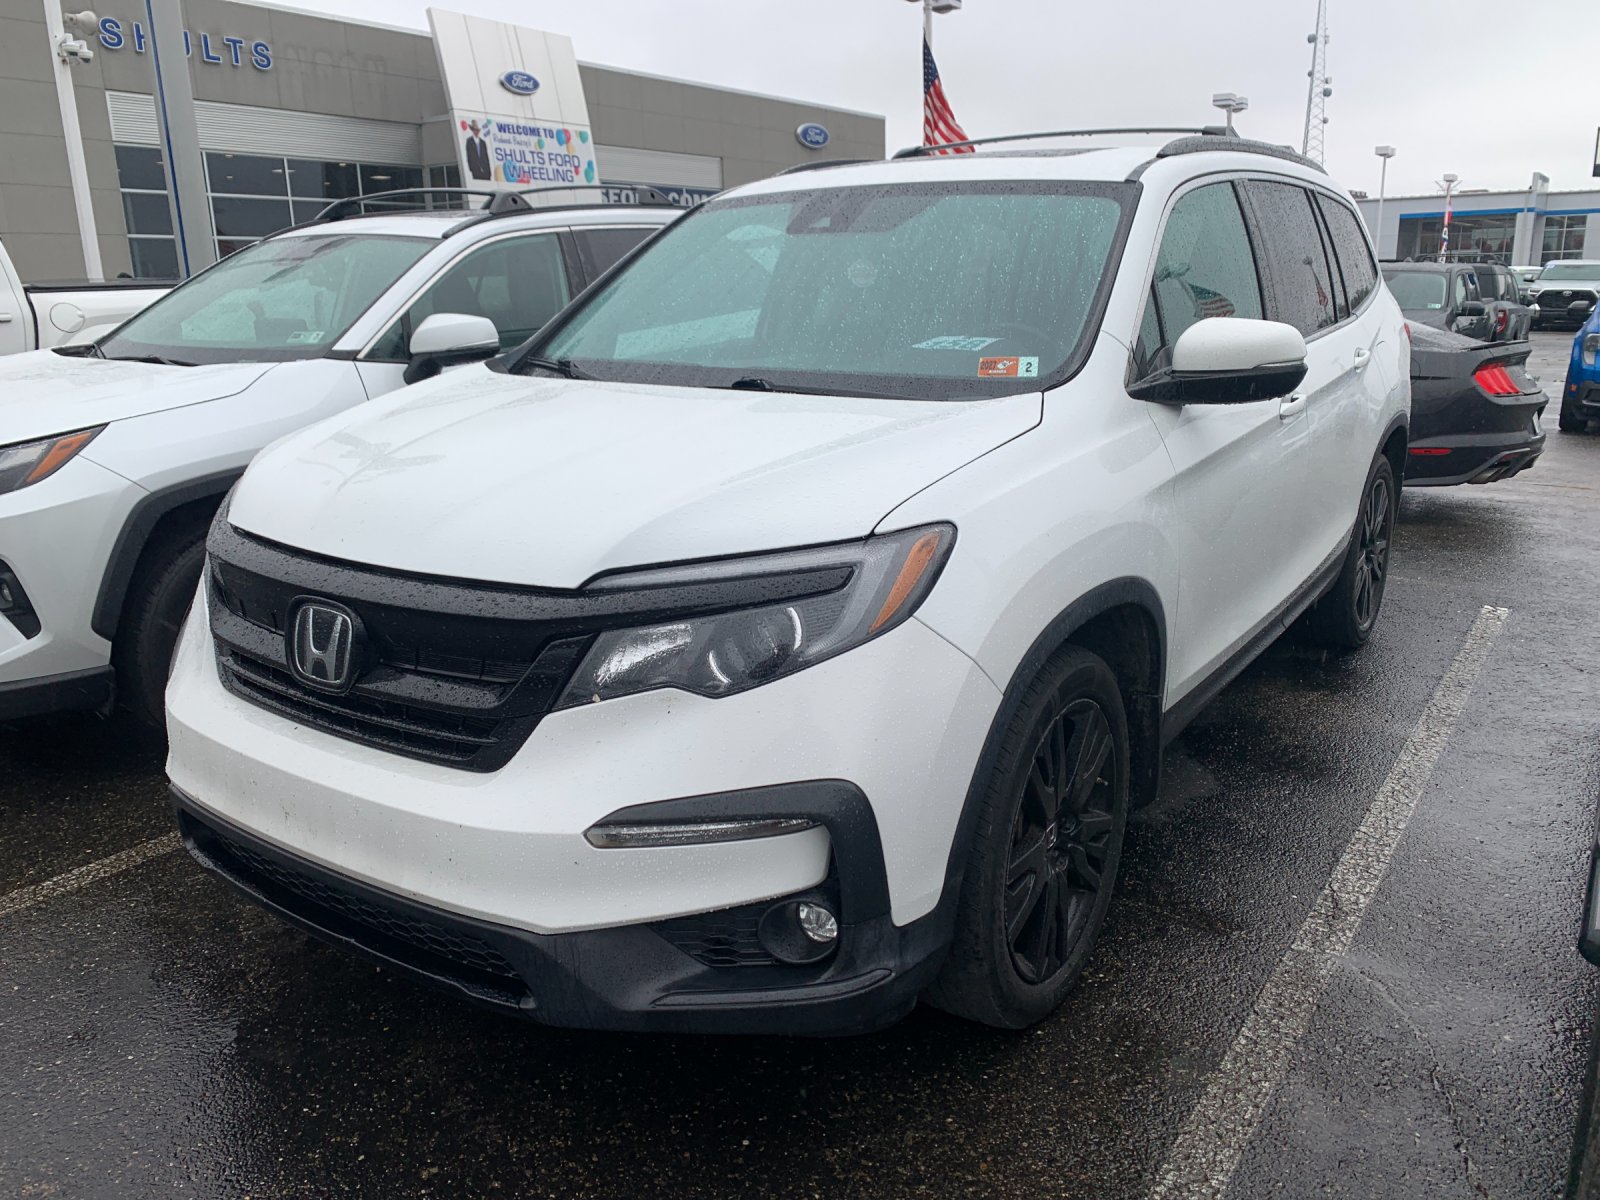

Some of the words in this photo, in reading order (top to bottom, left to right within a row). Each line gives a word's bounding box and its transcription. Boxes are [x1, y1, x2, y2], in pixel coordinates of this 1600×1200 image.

[496, 122, 541, 138] WELCOME
[543, 128, 555, 139] TO
[494, 147, 545, 165] SHULTS
[548, 152, 581, 168] FORD
[508, 165, 575, 183] WHEELING
[1025, 362, 1033, 373] 2
